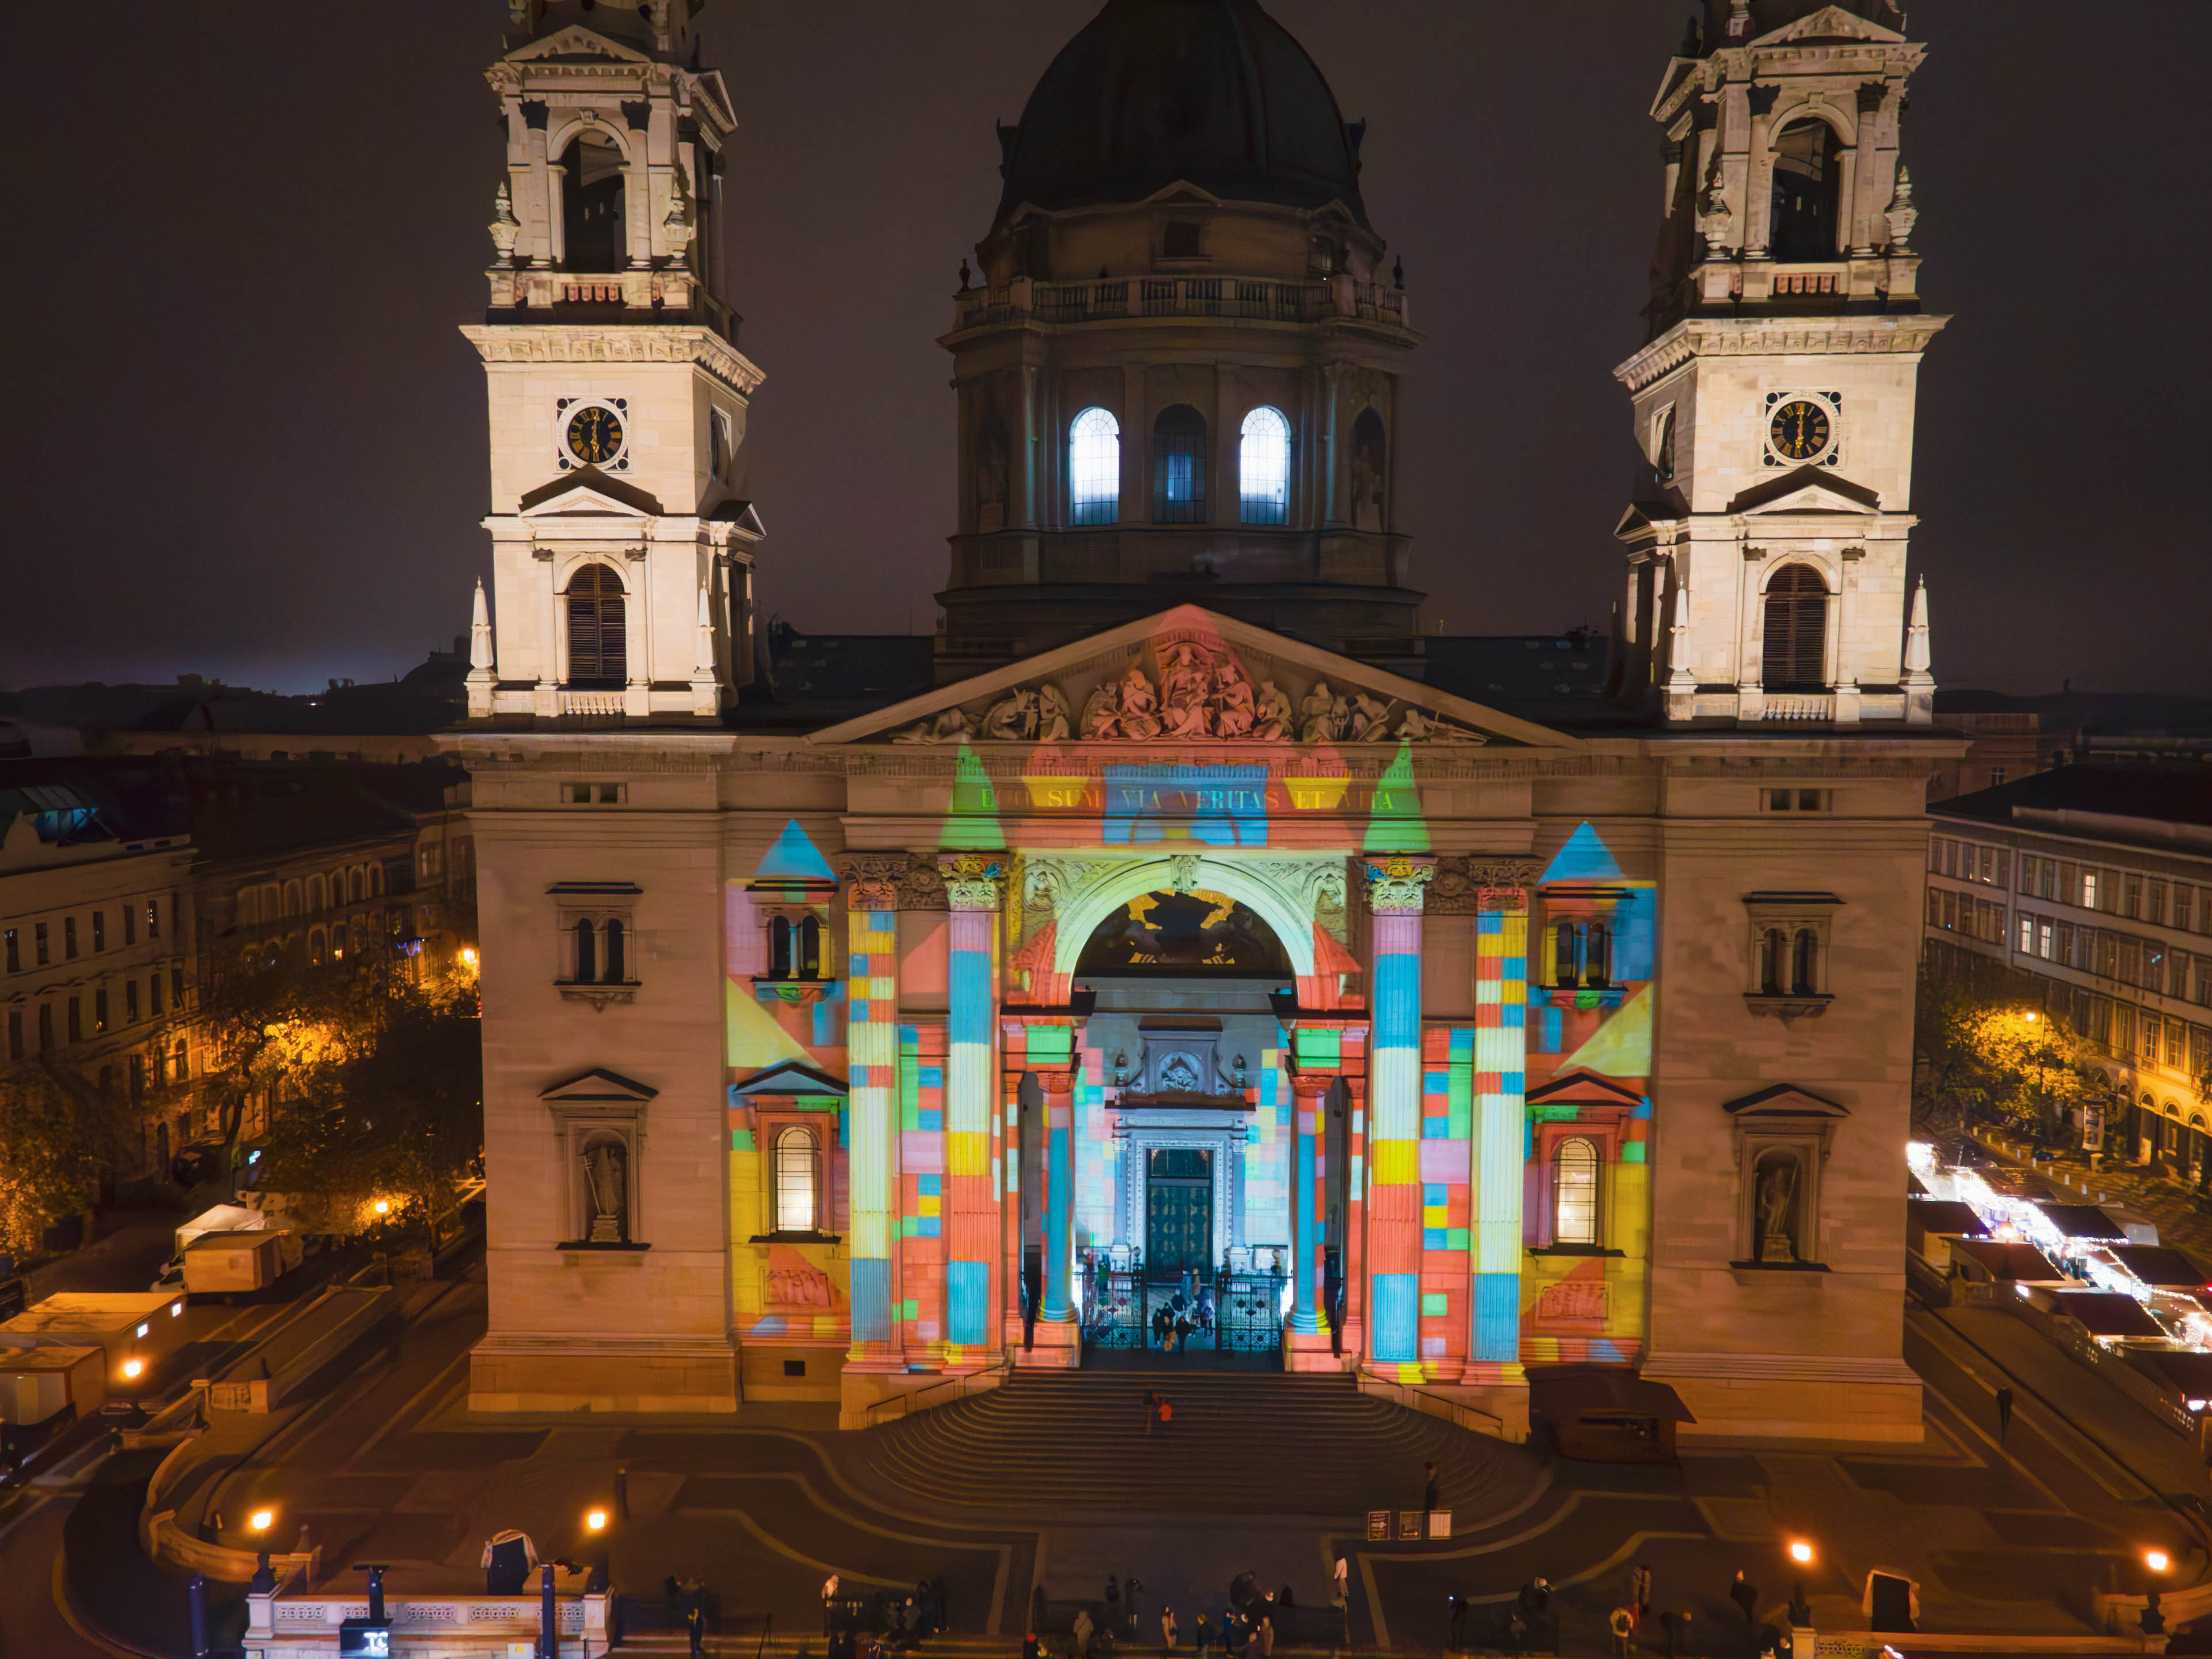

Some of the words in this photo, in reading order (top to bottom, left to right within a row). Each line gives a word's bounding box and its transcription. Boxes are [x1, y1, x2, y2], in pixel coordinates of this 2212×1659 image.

[1047, 789, 1100, 808] SUM
[1176, 790, 1279, 809] VERITAS
[1296, 790, 1324, 809] ET
